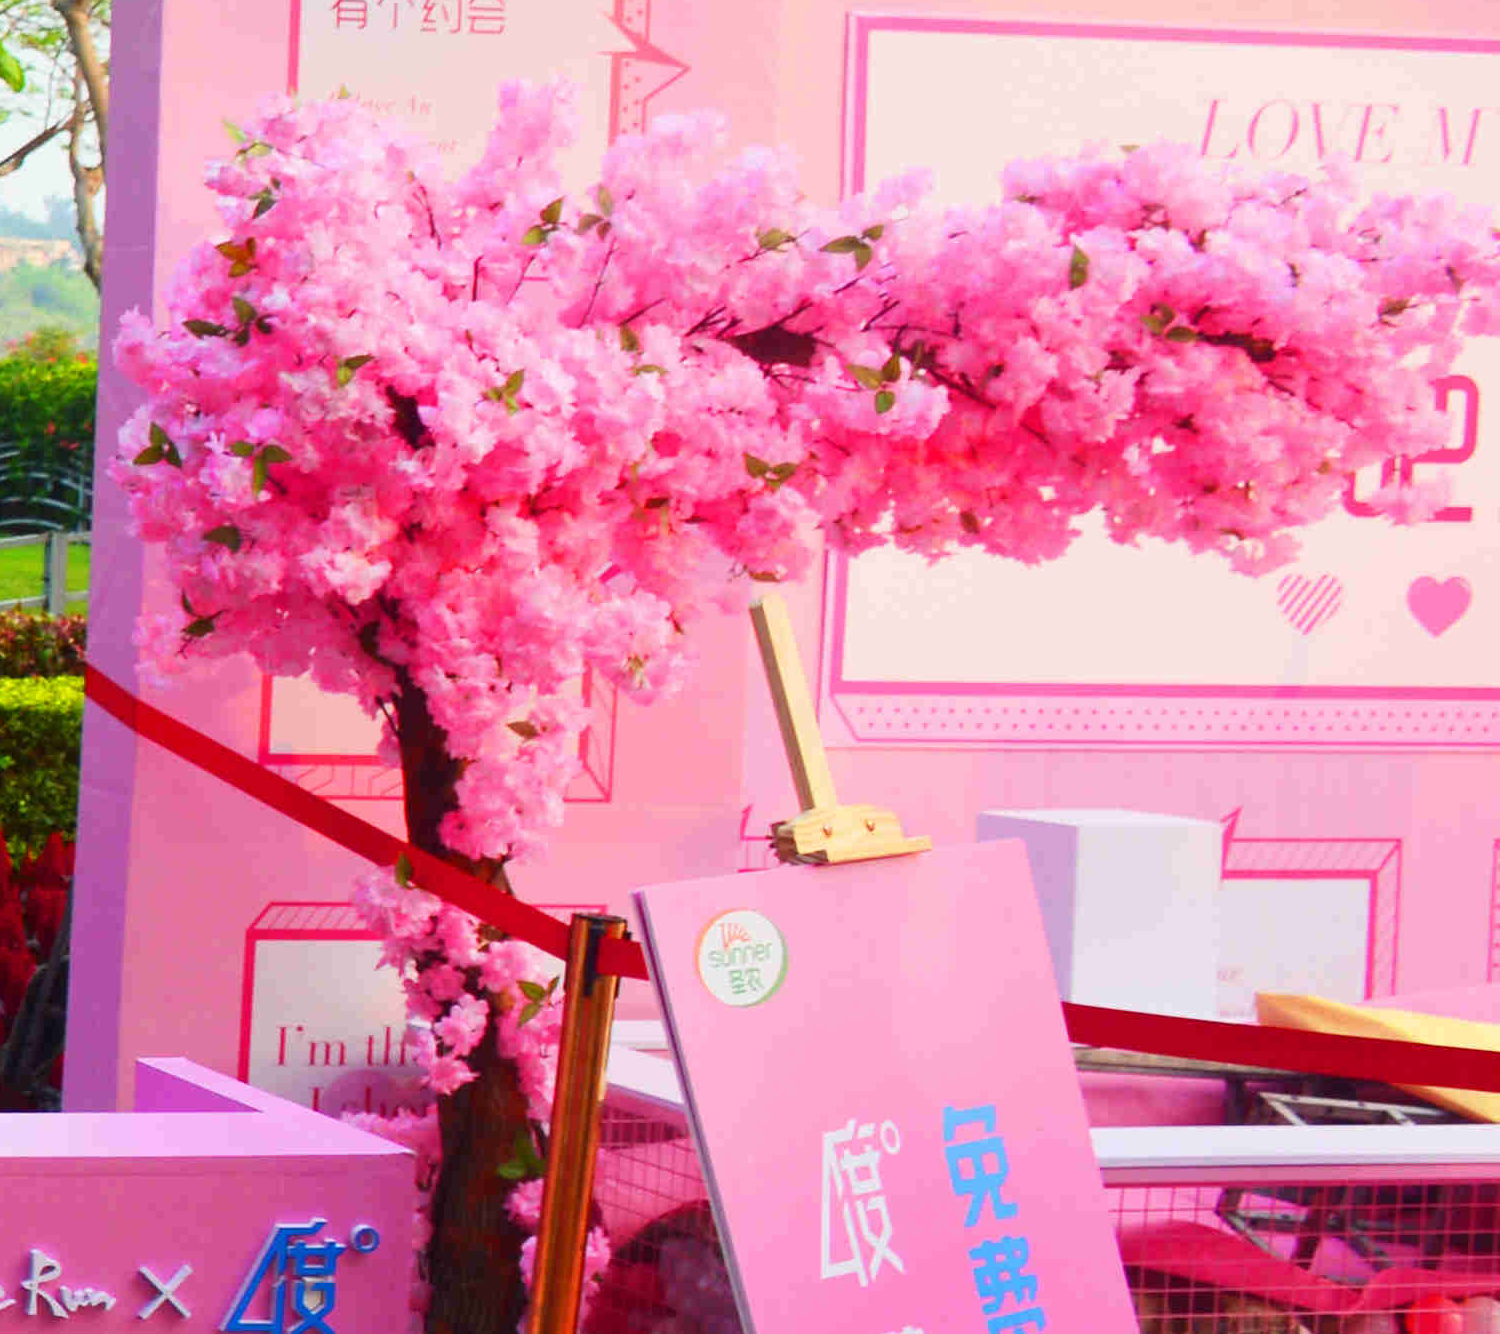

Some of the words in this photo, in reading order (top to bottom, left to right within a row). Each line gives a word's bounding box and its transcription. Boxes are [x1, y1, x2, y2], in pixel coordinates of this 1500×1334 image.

[1200, 98, 1399, 163] LOVE
[278, 1027, 347, 1066] I'm
[24, 1249, 115, 1319] Run
